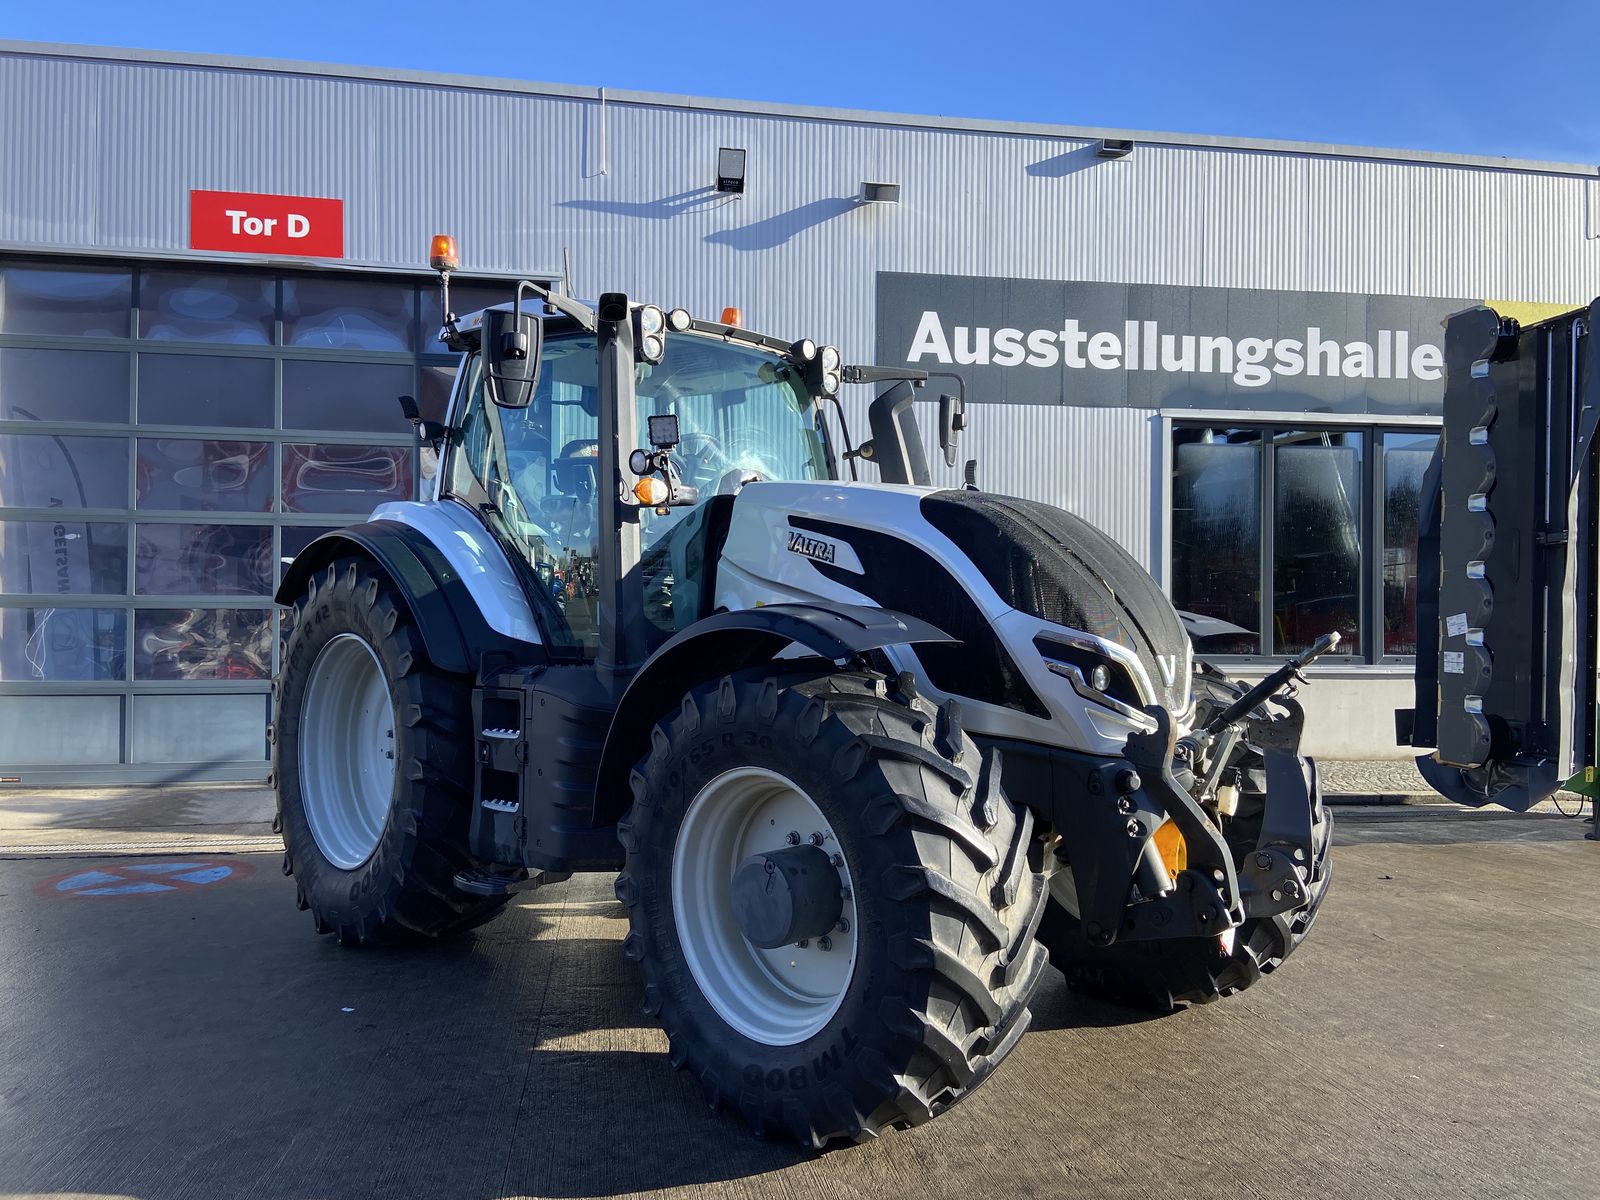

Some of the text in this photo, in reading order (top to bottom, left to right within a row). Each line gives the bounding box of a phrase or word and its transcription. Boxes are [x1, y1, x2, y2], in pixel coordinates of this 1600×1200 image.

[225, 209, 310, 238] Tor D
[906, 310, 1444, 387] Ausstellungshalle
[787, 531, 836, 564] VALTRA
